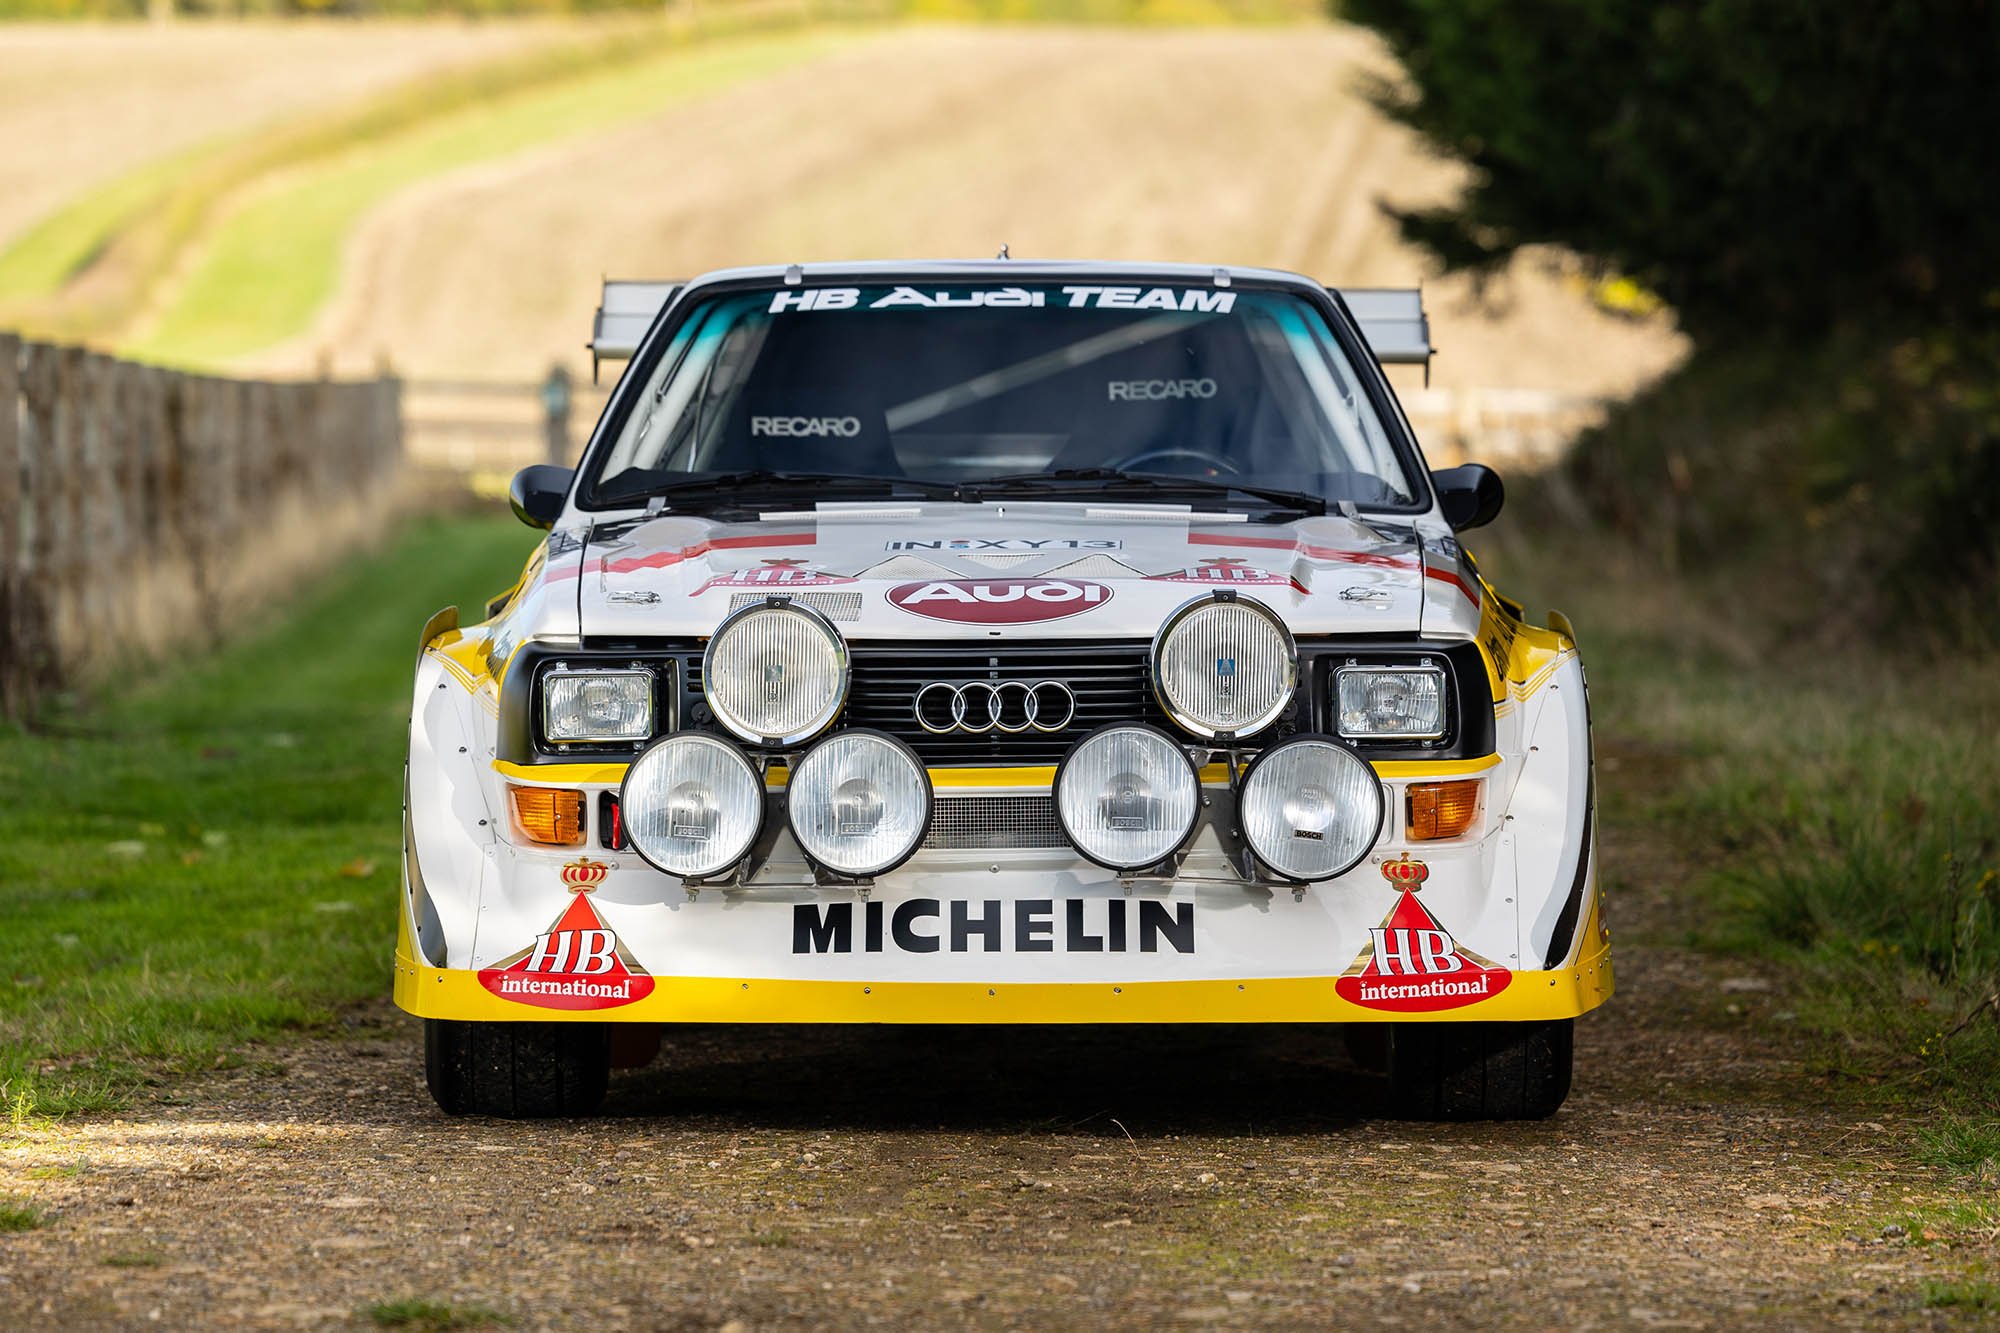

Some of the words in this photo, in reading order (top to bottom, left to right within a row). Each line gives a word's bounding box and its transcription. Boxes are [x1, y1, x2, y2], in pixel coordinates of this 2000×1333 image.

[768, 287, 860, 314] HB
[1062, 286, 1238, 314] TEAM
[1107, 378, 1218, 401] RECARO
[751, 416, 861, 437] RECARO
[1295, 830, 1323, 840] BOSCH
[792, 898, 1195, 954] MICHELIN
[523, 928, 618, 975] HB
[1369, 927, 1463, 977] HB
[500, 975, 631, 999] international
[1360, 974, 1489, 1001] international
